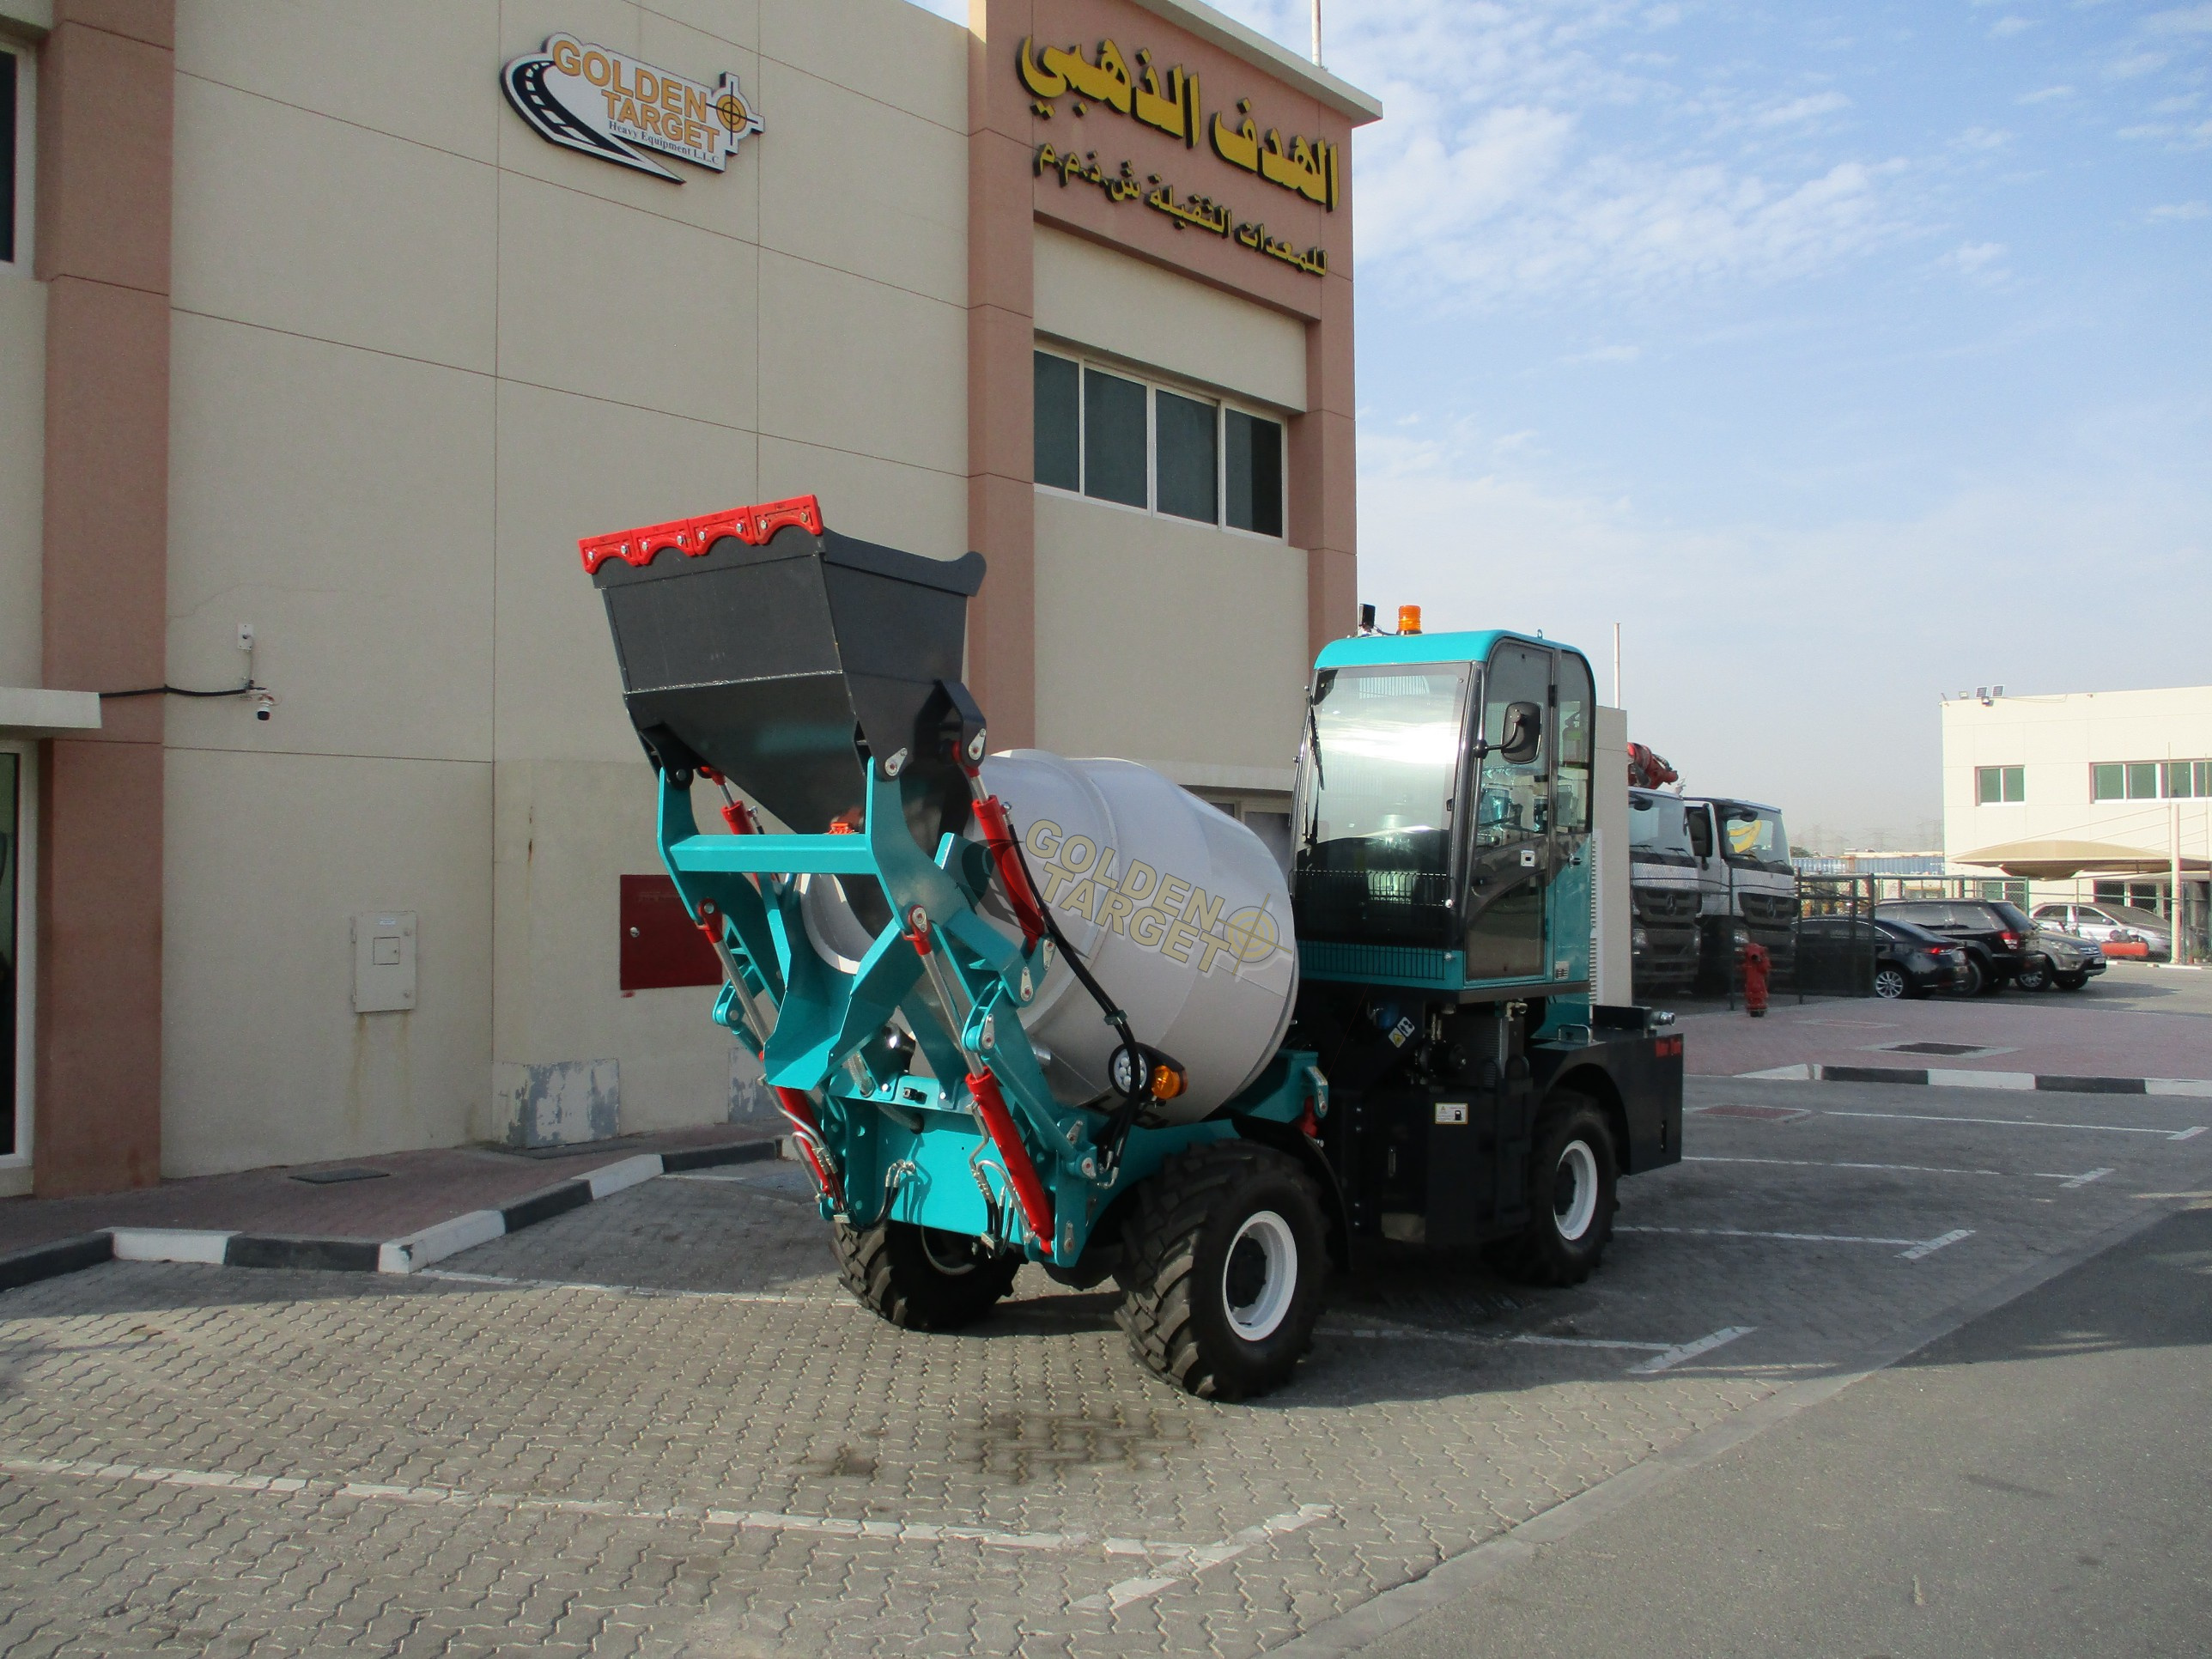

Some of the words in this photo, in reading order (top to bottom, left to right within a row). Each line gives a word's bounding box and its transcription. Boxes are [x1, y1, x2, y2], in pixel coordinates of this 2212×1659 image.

[552, 40, 708, 123] GOLDEN
[1017, 34, 1201, 149] الذهبي
[601, 89, 720, 153] TARGET
[609, 120, 638, 139] Heavy
[641, 131, 691, 155] Equipment
[1210, 97, 1339, 212] الهدف
[1144, 173, 1232, 239] الثقيلة
[1234, 222, 1328, 276] للمعدات
